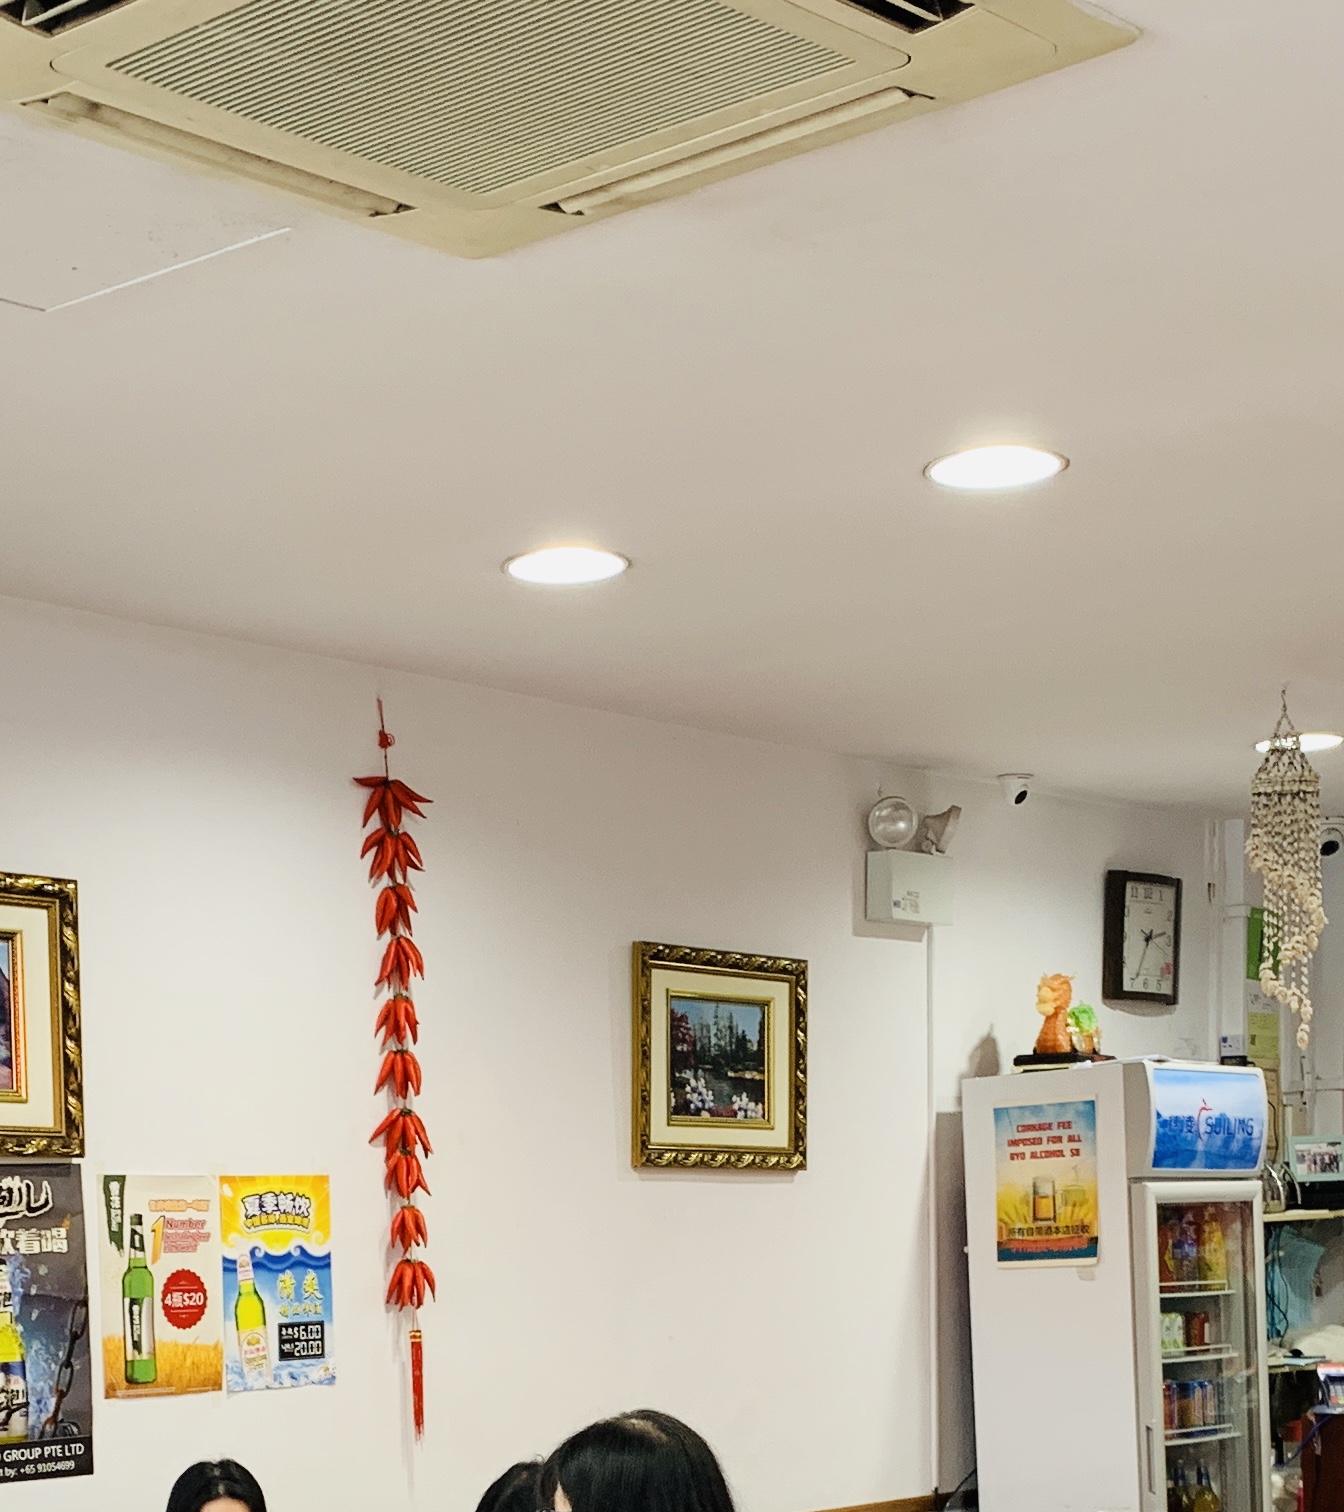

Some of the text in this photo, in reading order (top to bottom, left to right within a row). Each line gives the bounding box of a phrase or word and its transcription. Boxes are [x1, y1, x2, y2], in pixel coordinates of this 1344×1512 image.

[1057, 1120, 1072, 1131] FEE
[1007, 1134, 1082, 1147] IMPOSED FOR ALL
[1030, 1149, 1065, 1160] ALCOHOL
[164, 1291, 205, 1308] 4瓶$20
[3, 1447, 42, 1463] GROUP
[43, 1445, 63, 1459] PTE
[64, 1443, 85, 1456] LTD
[5, 1465, 18, 1479] by:
[19, 1463, 36, 1475] +65
